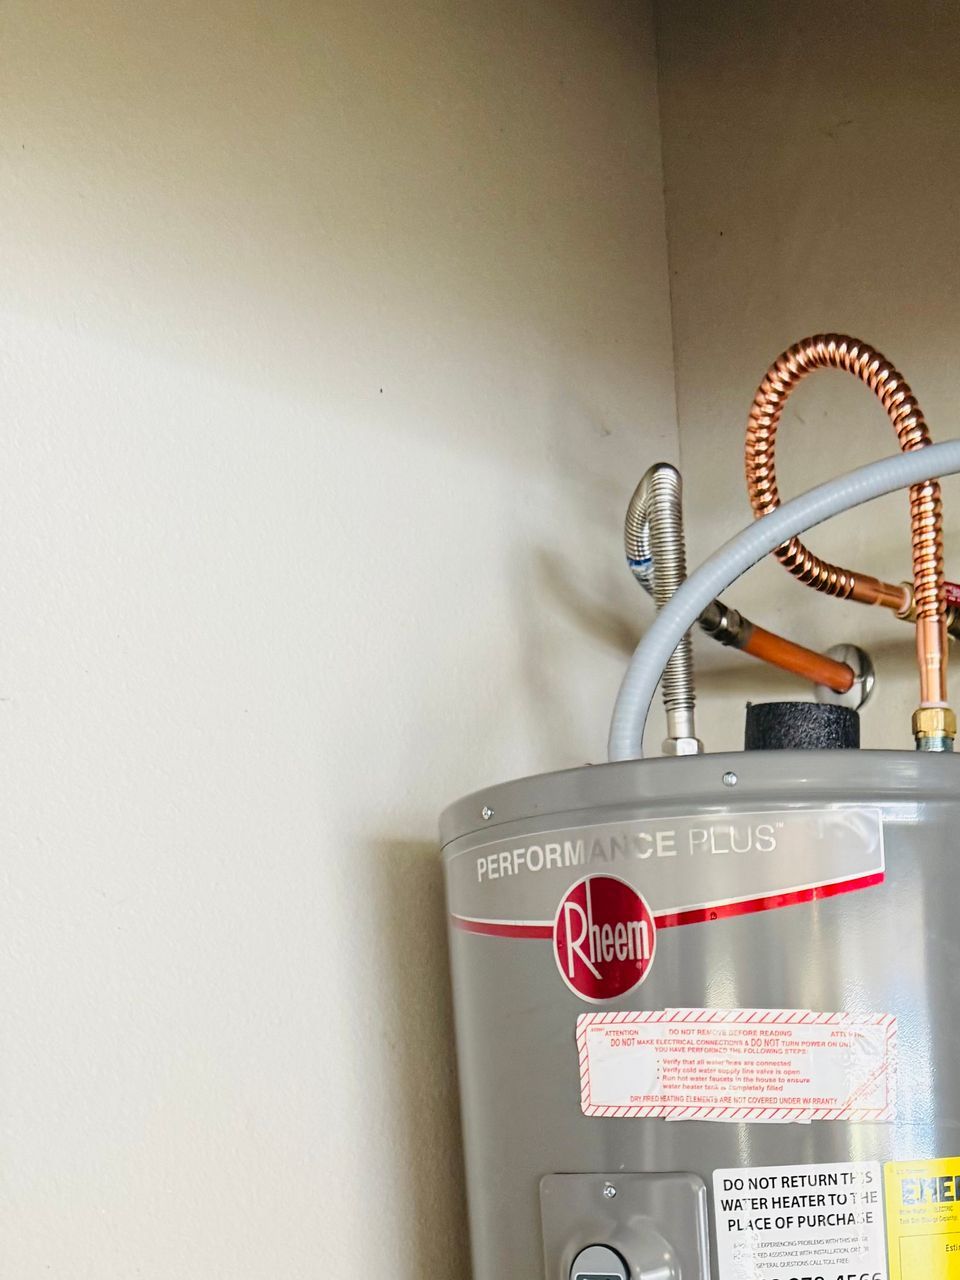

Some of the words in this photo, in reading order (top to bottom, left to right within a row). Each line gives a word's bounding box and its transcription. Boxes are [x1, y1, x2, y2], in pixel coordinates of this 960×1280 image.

[477, 831, 677, 883] PERFORMANCE
[564, 880, 650, 979] Rheem
[611, 1039, 620, 1047] DO
[622, 1038, 635, 1047] NOT
[751, 1038, 762, 1047] DO
[764, 1039, 780, 1047] NOT
[779, 1097, 800, 1105] UNDER
[723, 1179, 744, 1191] DO
[748, 1177, 777, 1190] NOT
[781, 1173, 838, 1188] RETURN
[772, 1194, 826, 1209] HEATER
[828, 1194, 847, 1205] TO
[775, 1217, 794, 1229] OF
